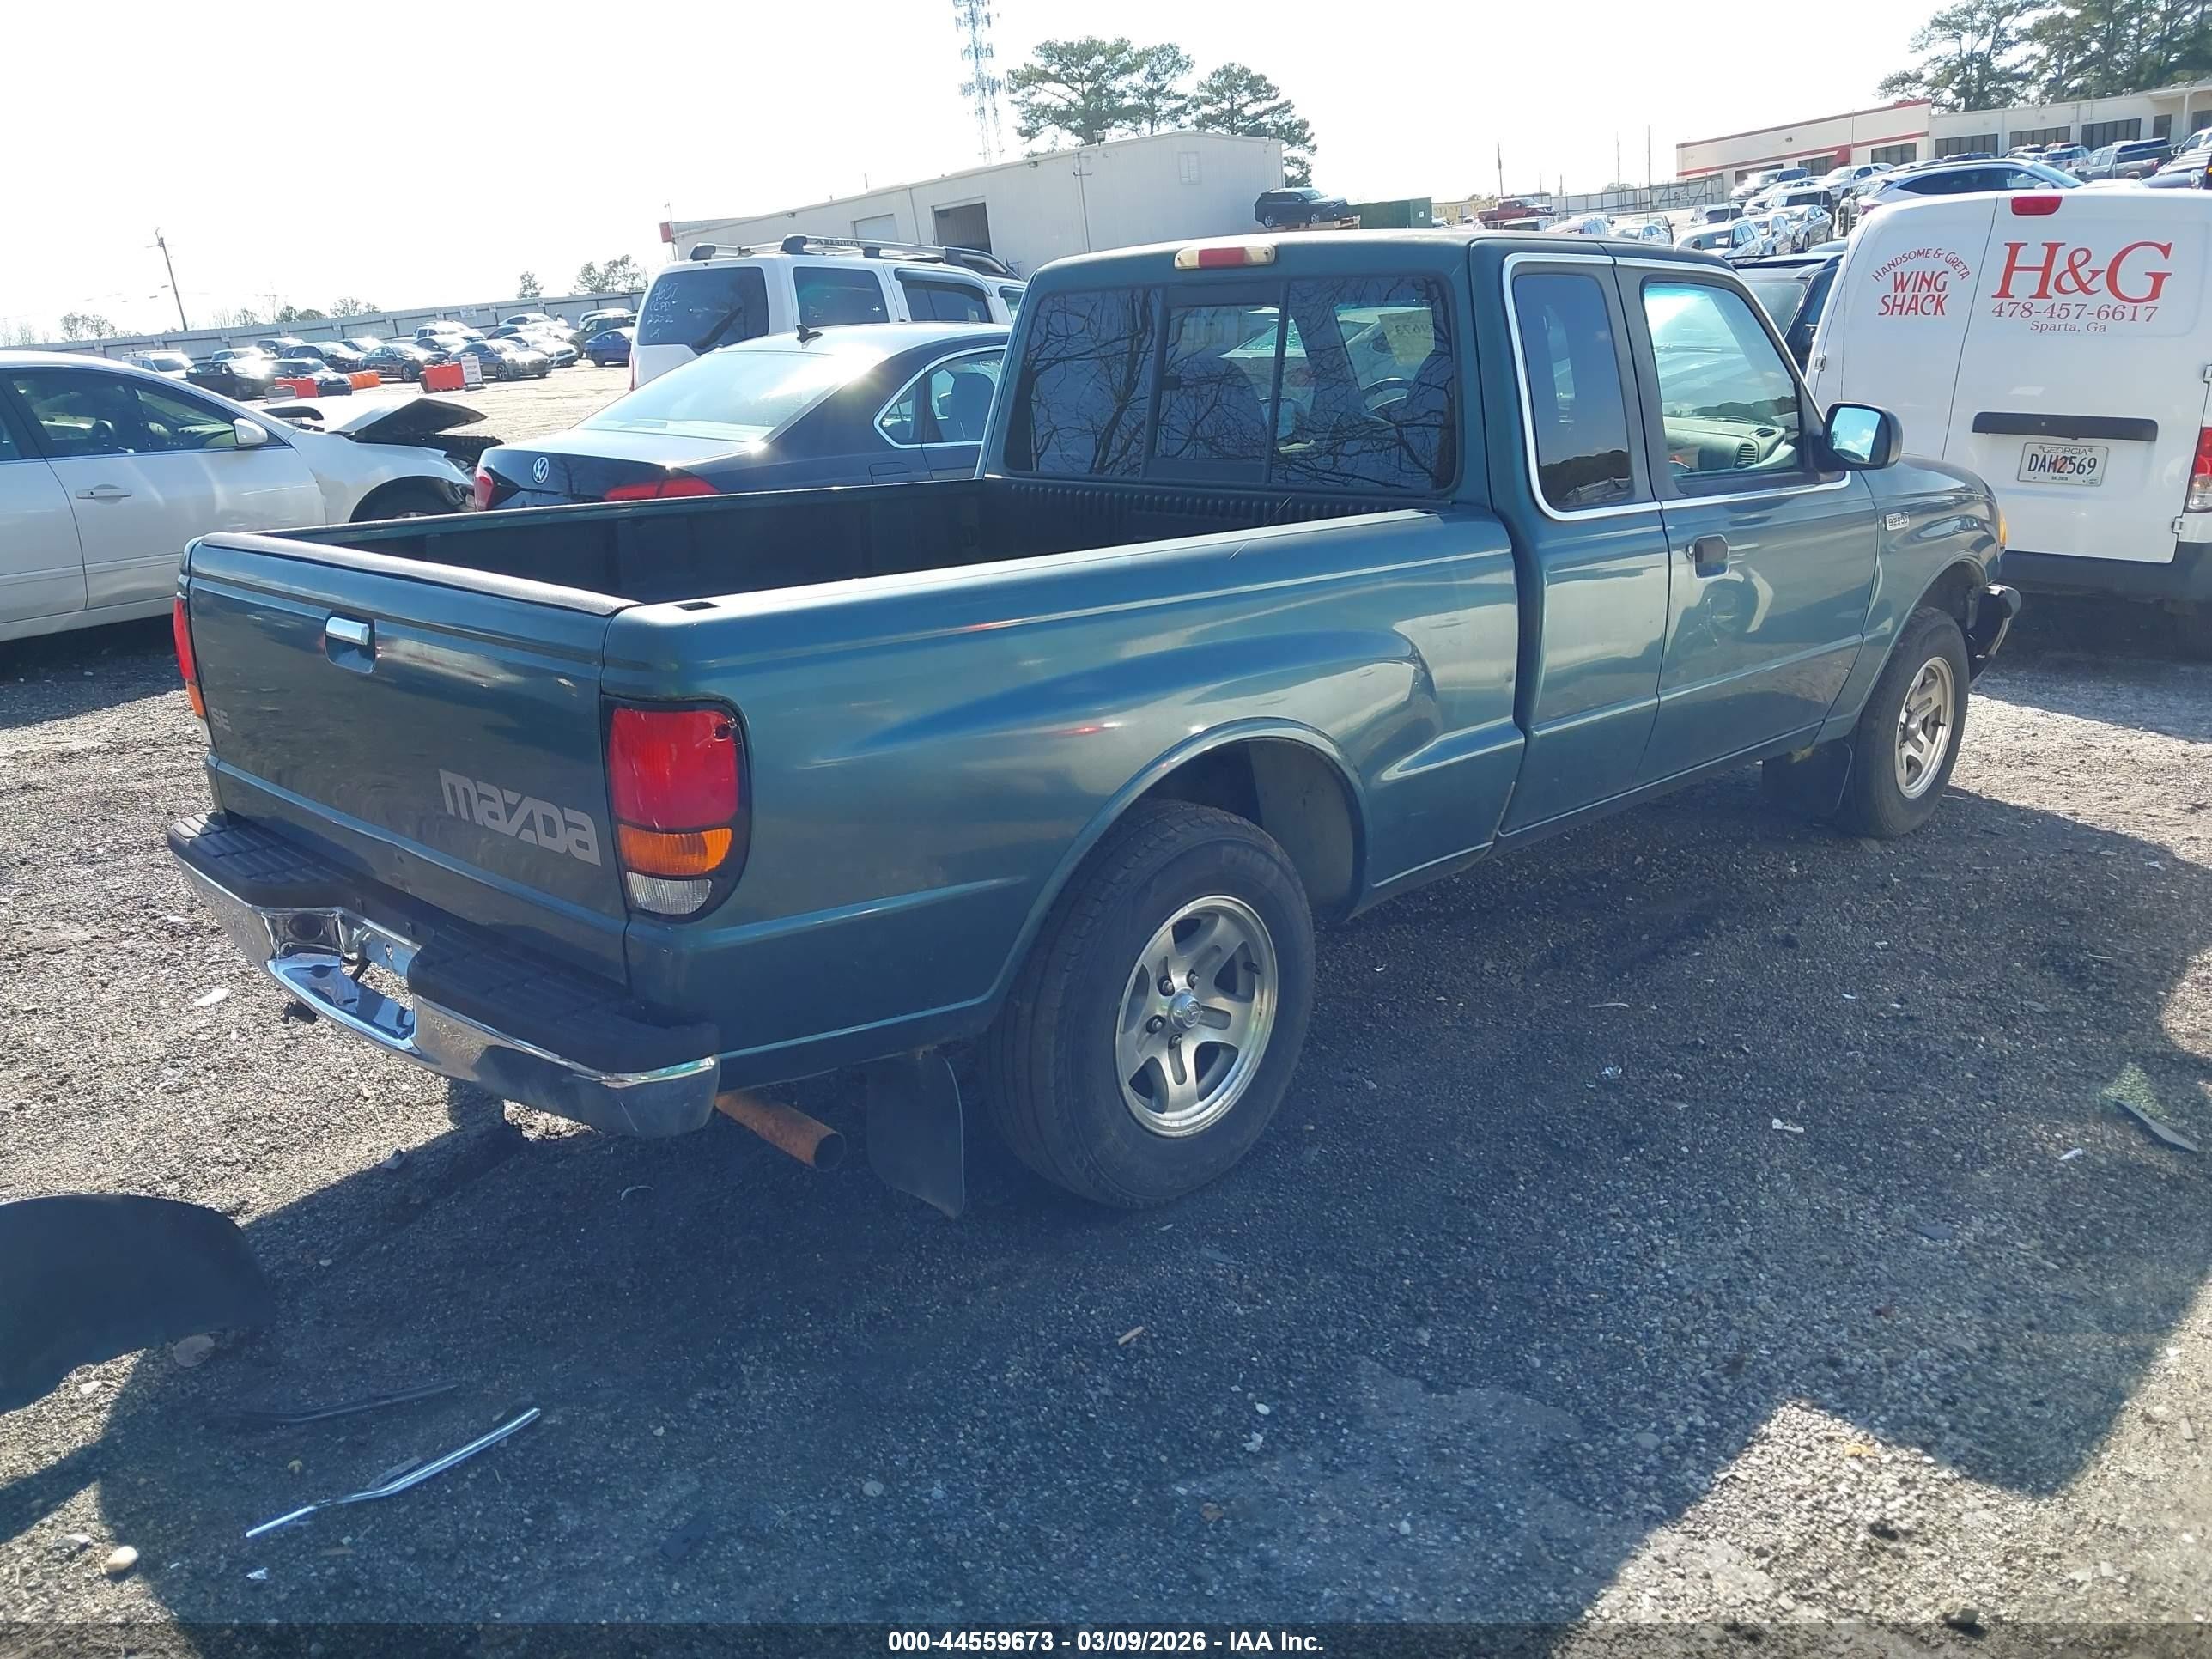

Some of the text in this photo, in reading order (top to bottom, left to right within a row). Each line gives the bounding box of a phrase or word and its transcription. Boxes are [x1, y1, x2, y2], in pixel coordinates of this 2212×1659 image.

[1872, 248, 1971, 282] HANDSOME & GRETA
[1991, 241, 2172, 303] H&G
[1893, 270, 1948, 293] WING
[1878, 294, 1950, 316] SHACK
[1991, 301, 2159, 322] 478-457-6617
[2030, 320, 2107, 333] Sparta, Ga
[2042, 446, 2087, 455] GEORGIA
[2027, 453, 2097, 475] DAH2569
